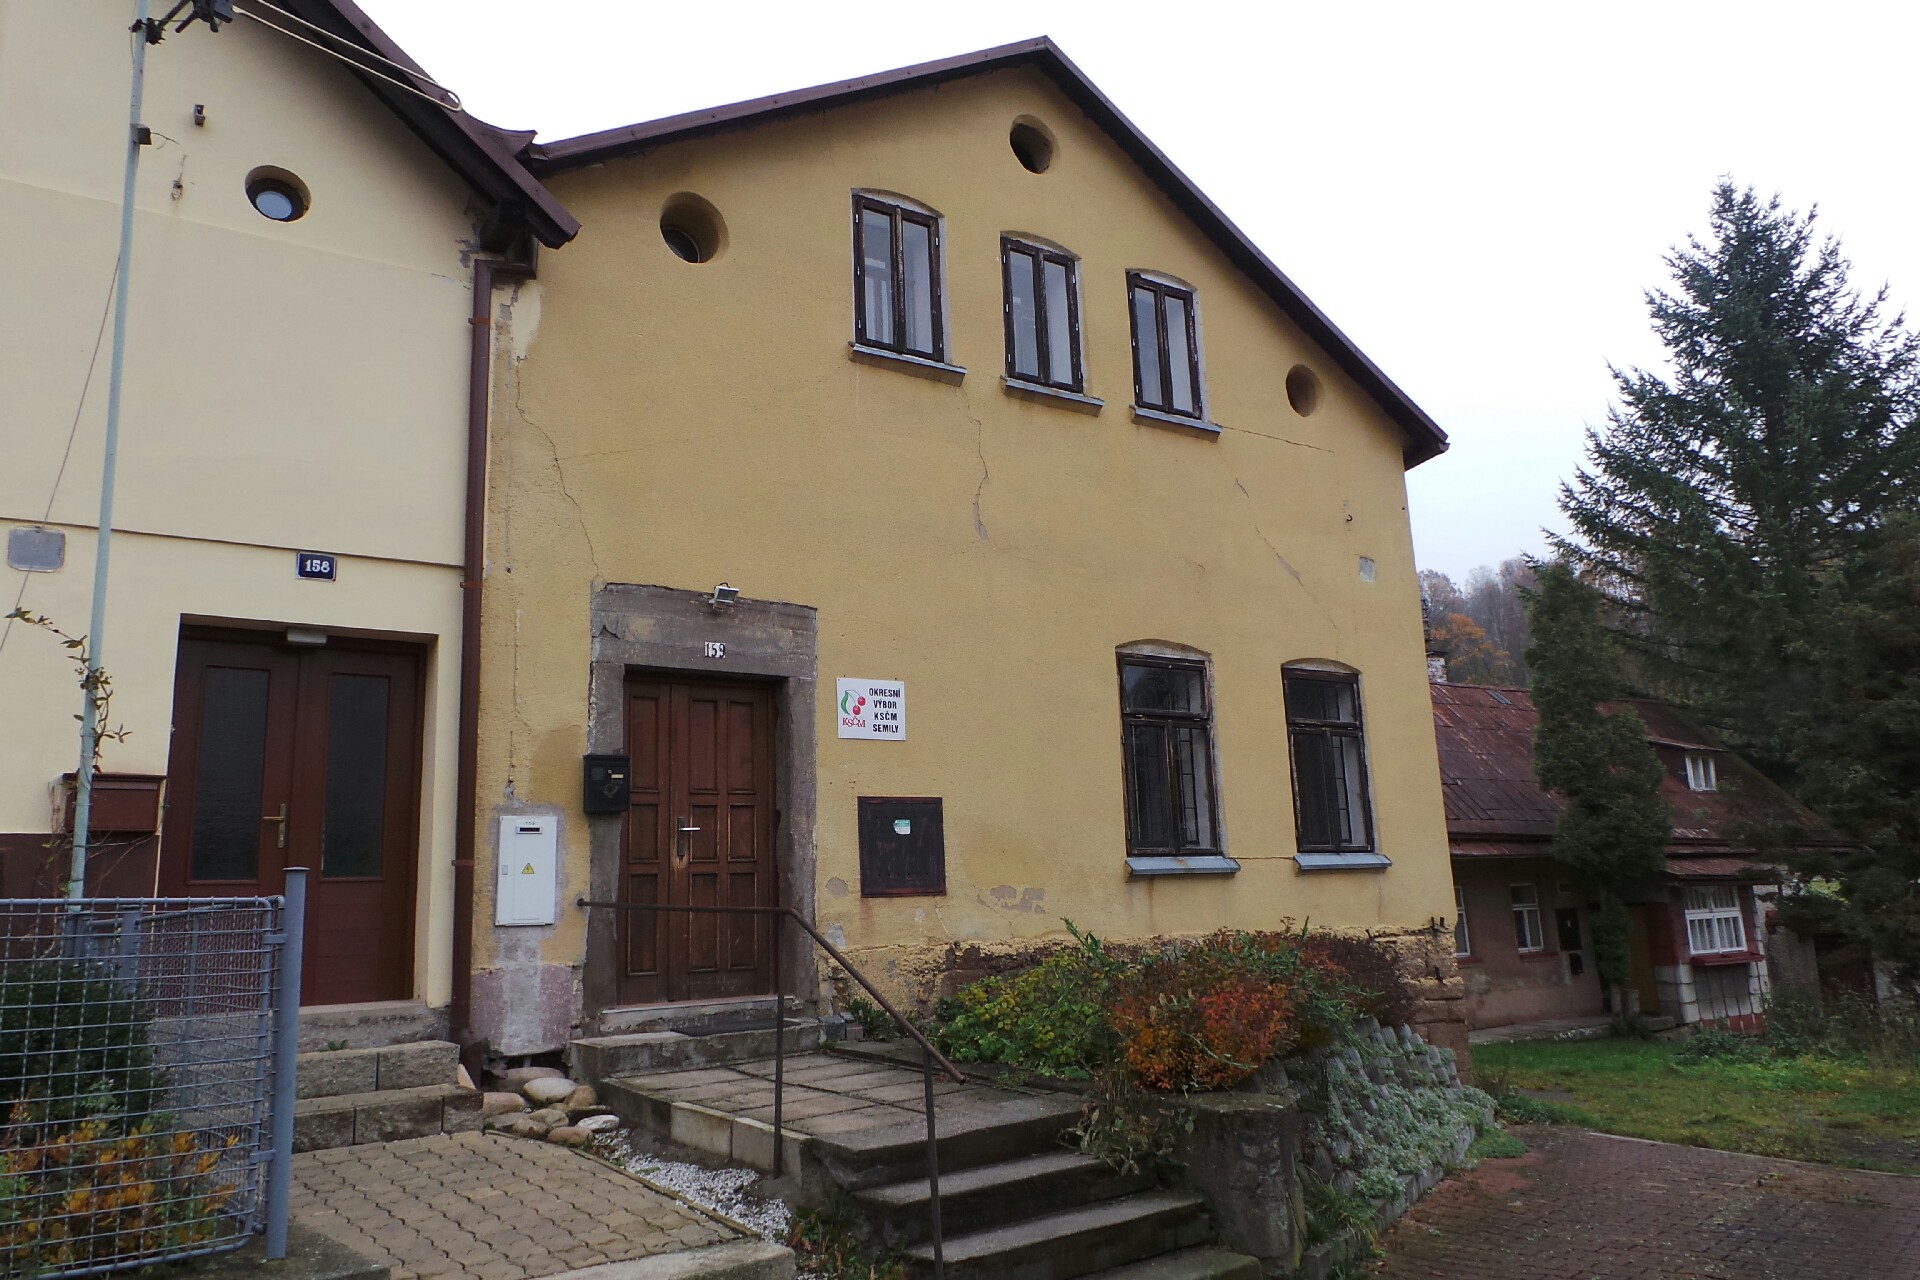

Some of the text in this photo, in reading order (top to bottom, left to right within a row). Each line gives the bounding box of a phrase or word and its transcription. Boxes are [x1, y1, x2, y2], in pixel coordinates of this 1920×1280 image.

[304, 559, 331, 573] 158
[704, 642, 726, 658] 159
[868, 687, 901, 698] OKRESNÍ
[873, 698, 897, 710] VÝBOR
[842, 715, 866, 728] KSČM
[873, 710, 898, 721] KSČM
[872, 723, 899, 734] SEMILY
